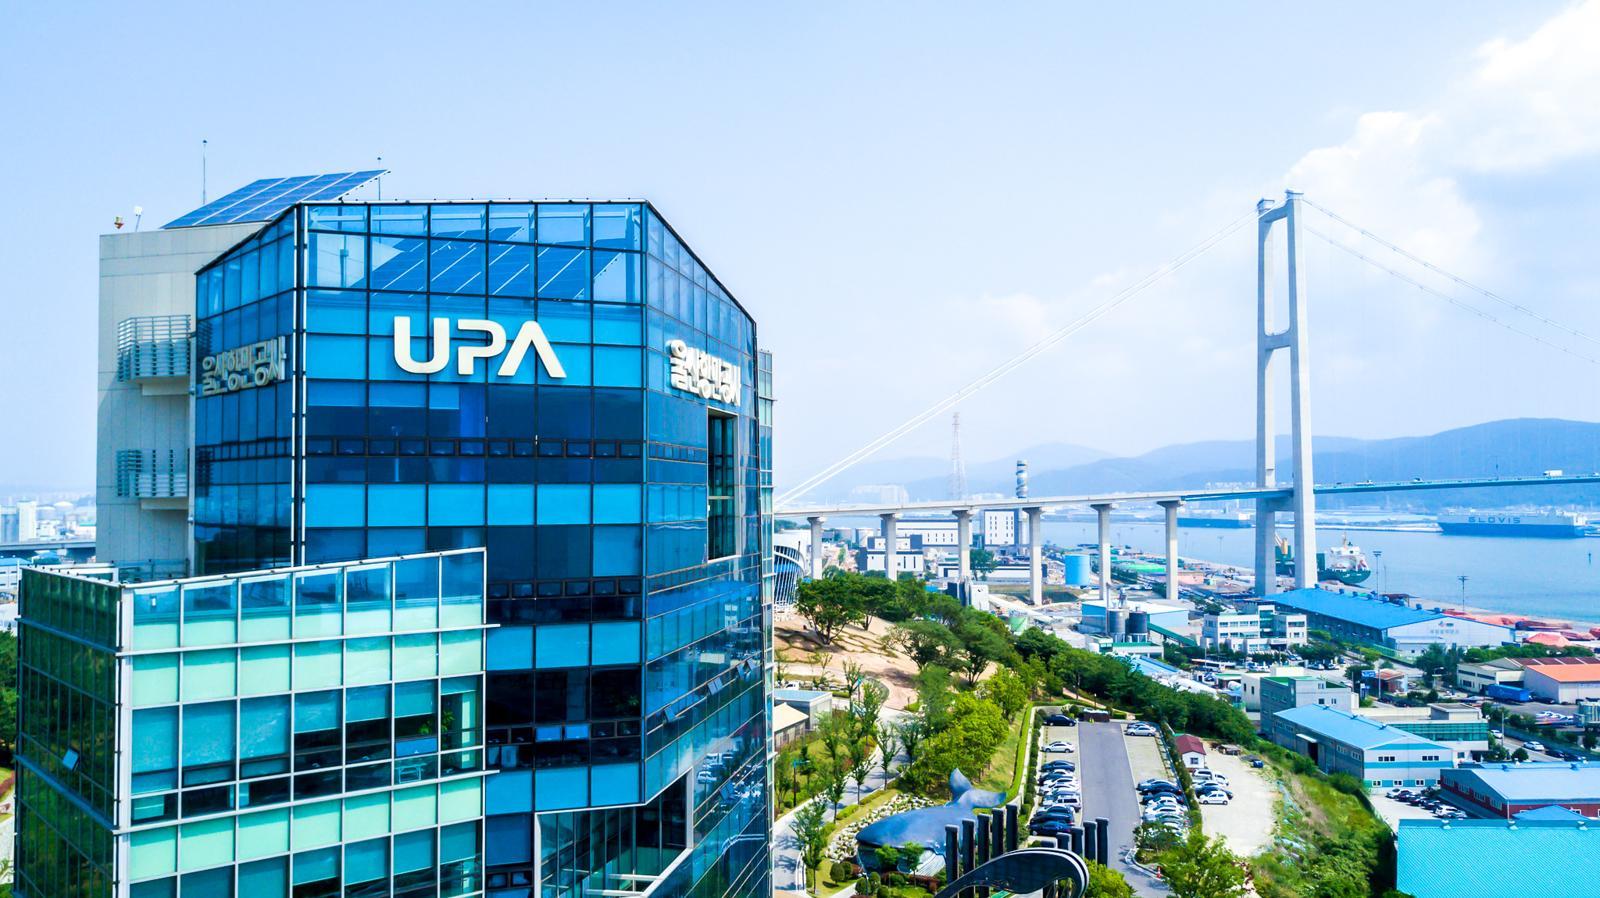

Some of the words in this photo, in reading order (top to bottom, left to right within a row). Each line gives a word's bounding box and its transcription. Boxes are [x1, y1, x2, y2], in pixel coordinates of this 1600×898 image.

[202, 335, 287, 396] 울산항만공사
[394, 316, 567, 378] UPA
[669, 339, 741, 407] 울산항만공사
[1468, 516, 1521, 524] GLOVIS
